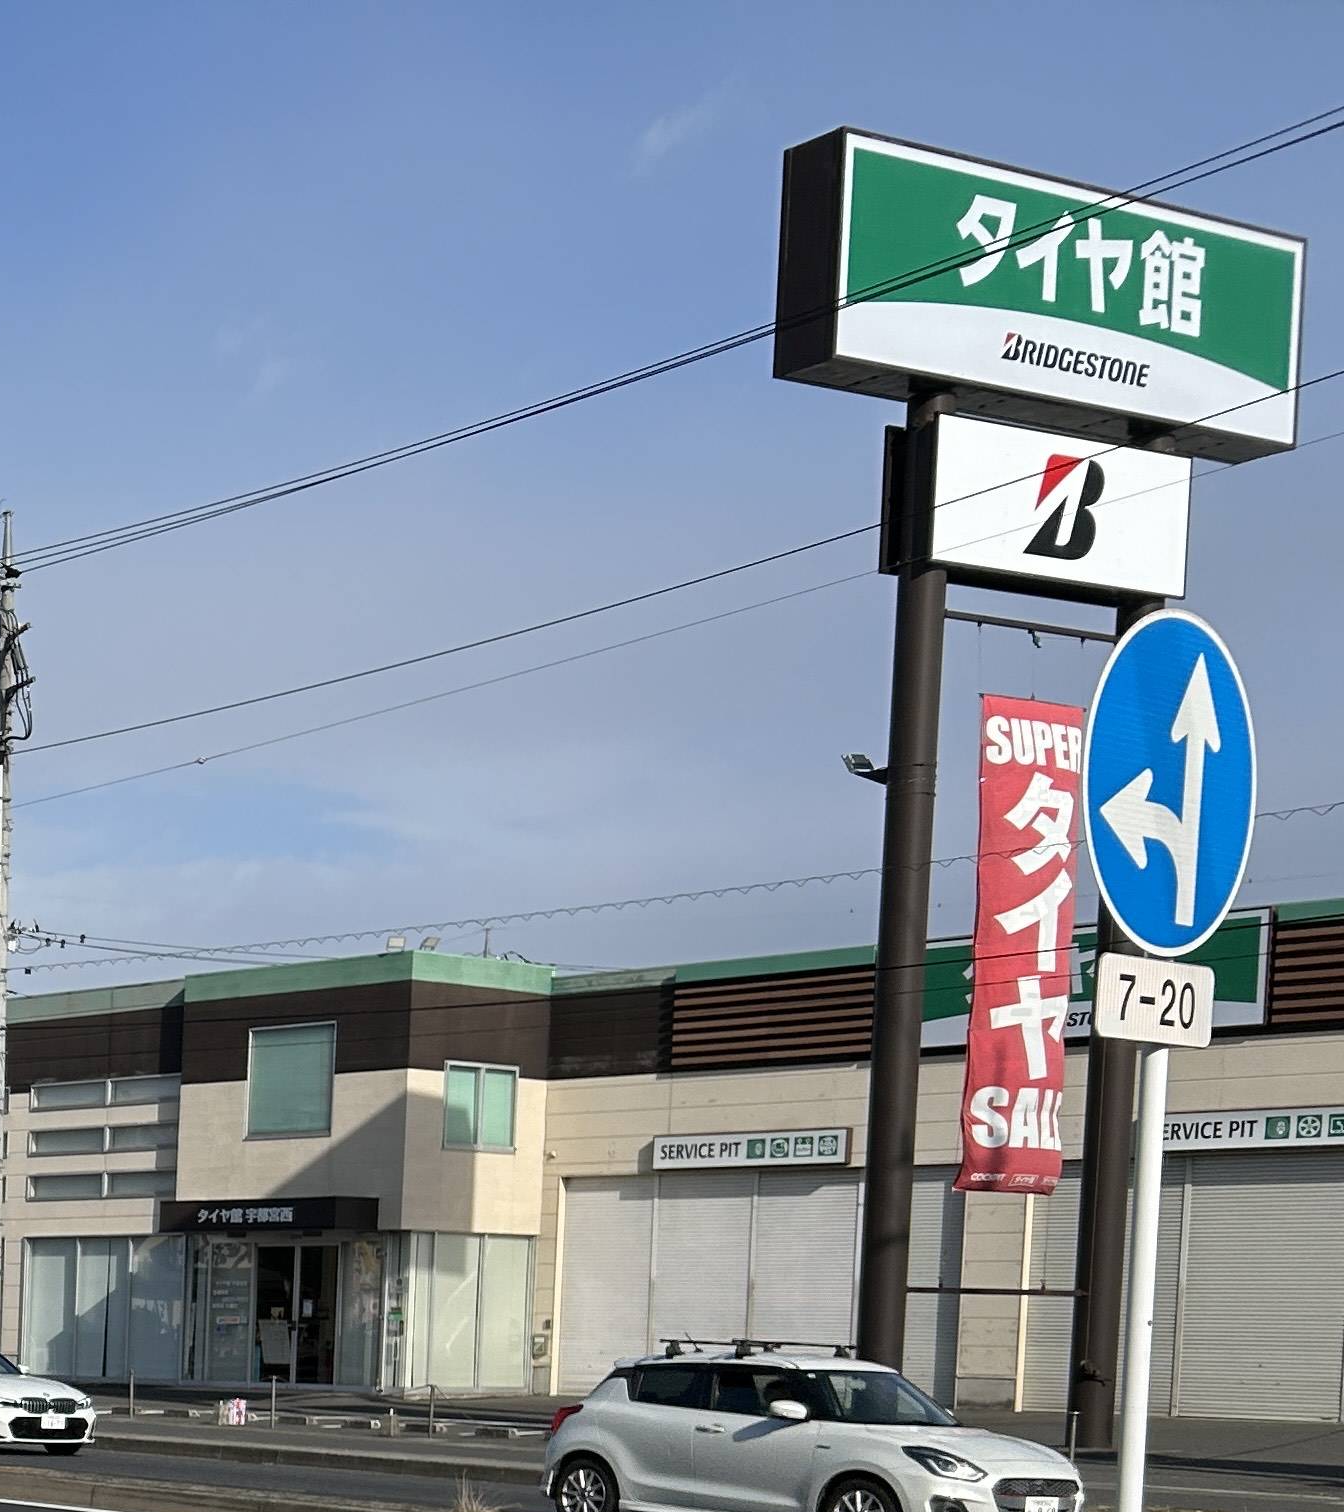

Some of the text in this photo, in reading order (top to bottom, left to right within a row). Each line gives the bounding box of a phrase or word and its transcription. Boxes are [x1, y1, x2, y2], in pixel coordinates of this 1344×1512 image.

[956, 194, 1205, 338] タイヤ館
[1001, 332, 1150, 388] BRIDGESTONE
[986, 715, 1082, 774] SUPER
[990, 771, 1074, 1080] タイヤ
[1119, 974, 1196, 1029] 7-20
[660, 1142, 742, 1160] SERVICE PIT
[1162, 1119, 1258, 1141] ERVICE PIT
[198, 1208, 243, 1224] タイヤ館
